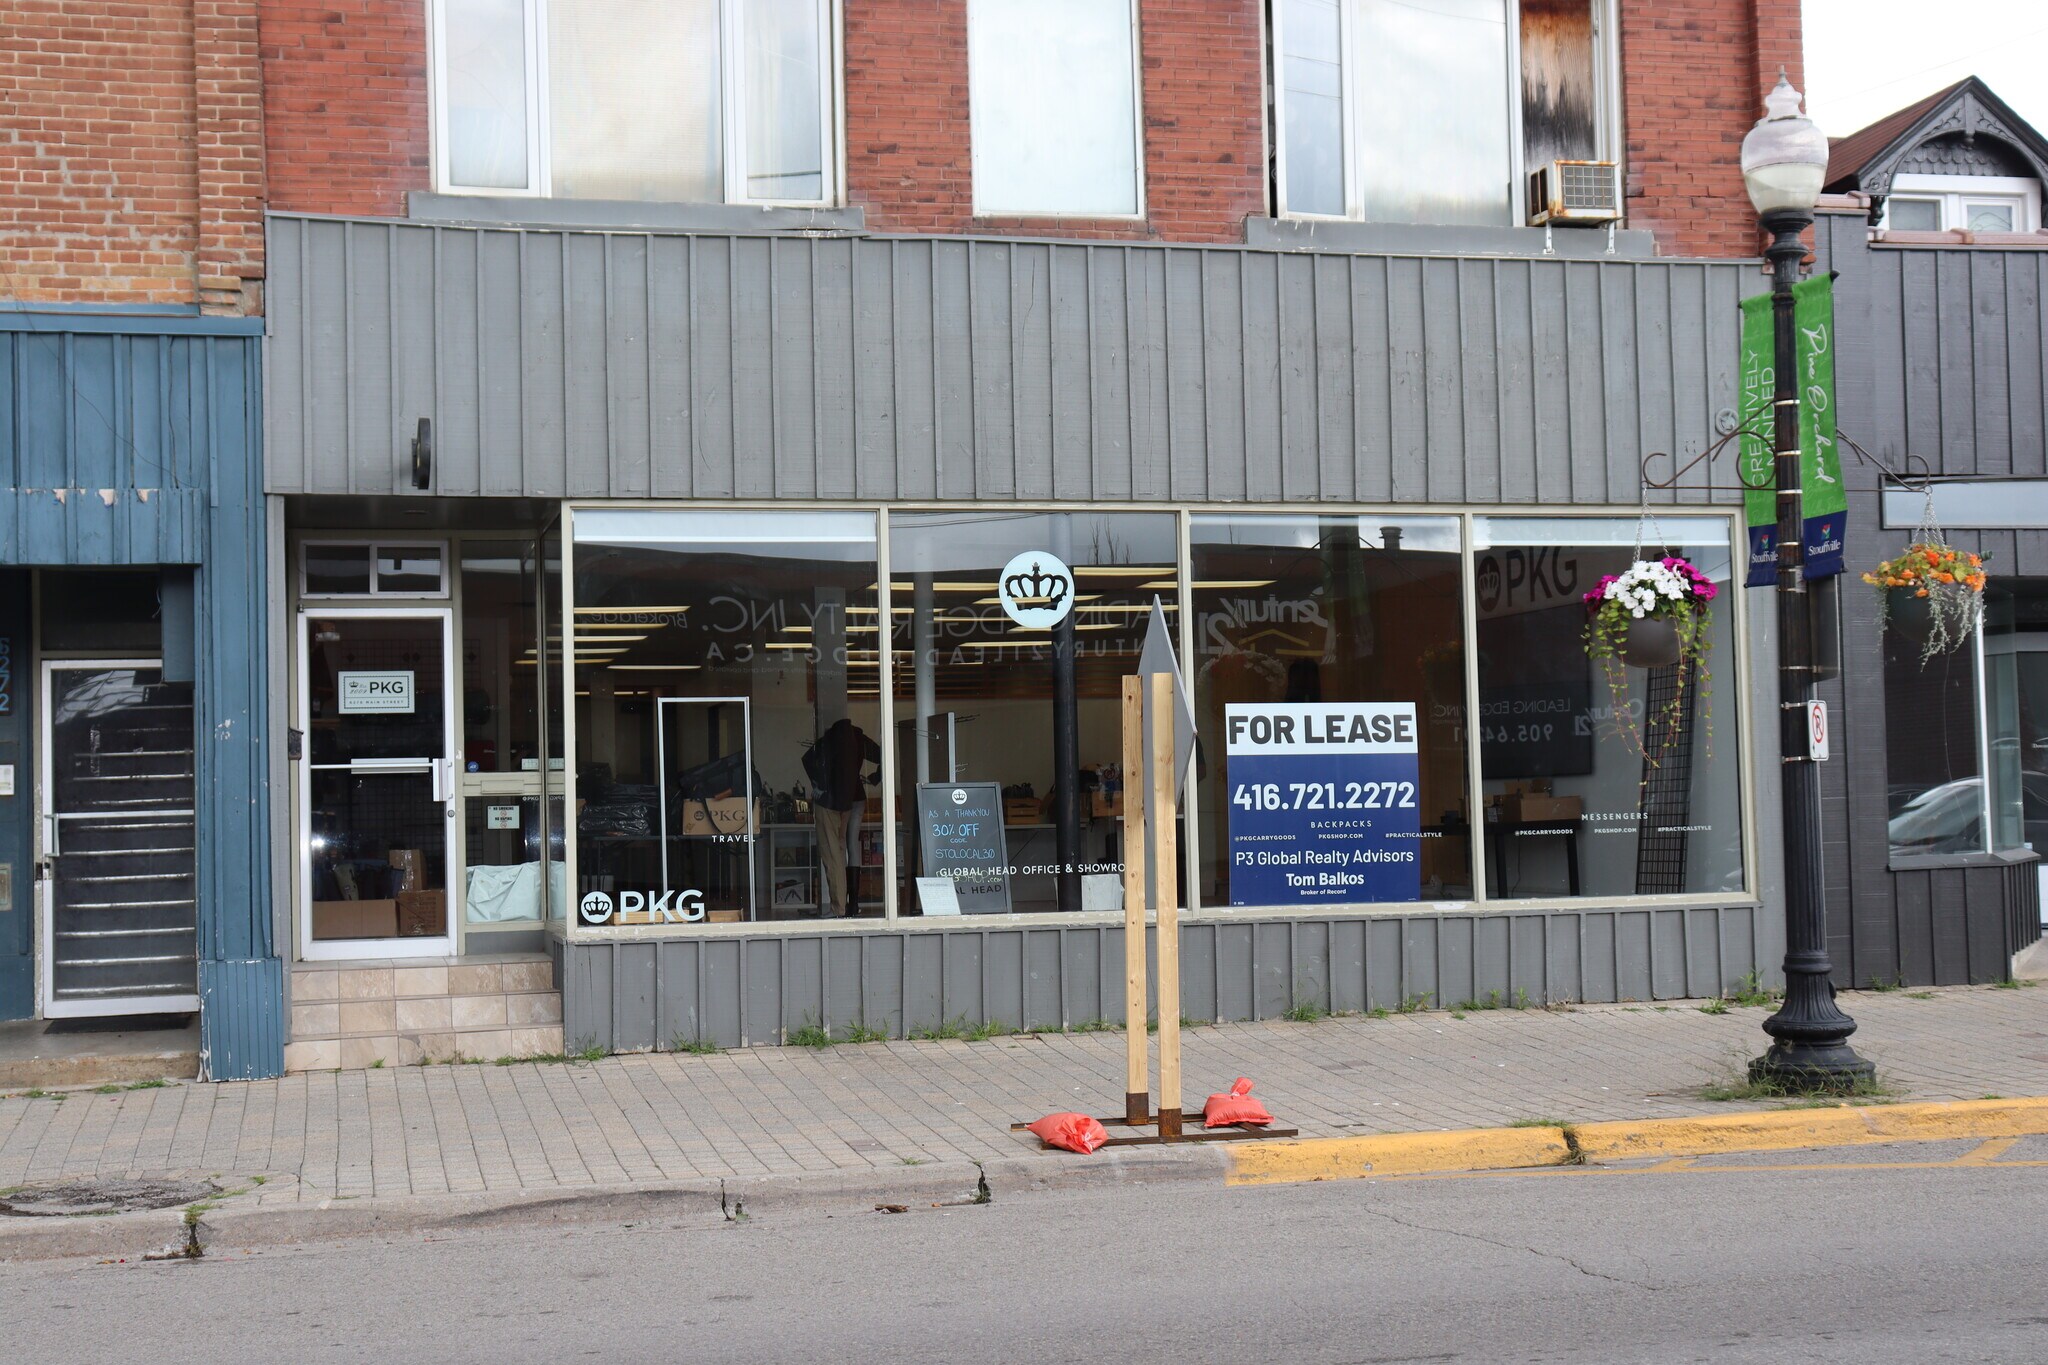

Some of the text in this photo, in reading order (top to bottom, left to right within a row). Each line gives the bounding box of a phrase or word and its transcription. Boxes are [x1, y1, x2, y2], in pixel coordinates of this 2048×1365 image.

[1802, 323, 1836, 484] Pine Orchard
[1745, 350, 1766, 488] CREATIVELY
[1761, 366, 1776, 467] MINDED
[1808, 538, 1842, 557] Stouffville
[1751, 550, 1779, 563] Stouffville
[1506, 546, 1578, 608] PKG
[369, 681, 404, 694] PKG
[1228, 714, 1414, 745] FOR LEASE
[1233, 781, 1416, 810] 416.721.2272
[711, 808, 746, 822] PKG
[928, 809, 939, 819] AS
[944, 809, 950, 818] A
[1581, 812, 1648, 821] MESSENGERS
[932, 822, 980, 837] 30% OFF
[1310, 820, 1373, 829] BACKPACKS
[1515, 828, 1574, 836] @PKGCARRYGOODS
[712, 834, 756, 843] TRAVEL
[1235, 849, 1414, 867] P3 Global Realty Advisors
[939, 863, 1126, 876] GLOBAL HEAD OFFICE & SHOWRO
[1286, 872, 1365, 887] Tom Balkos
[619, 889, 705, 922] PKG
